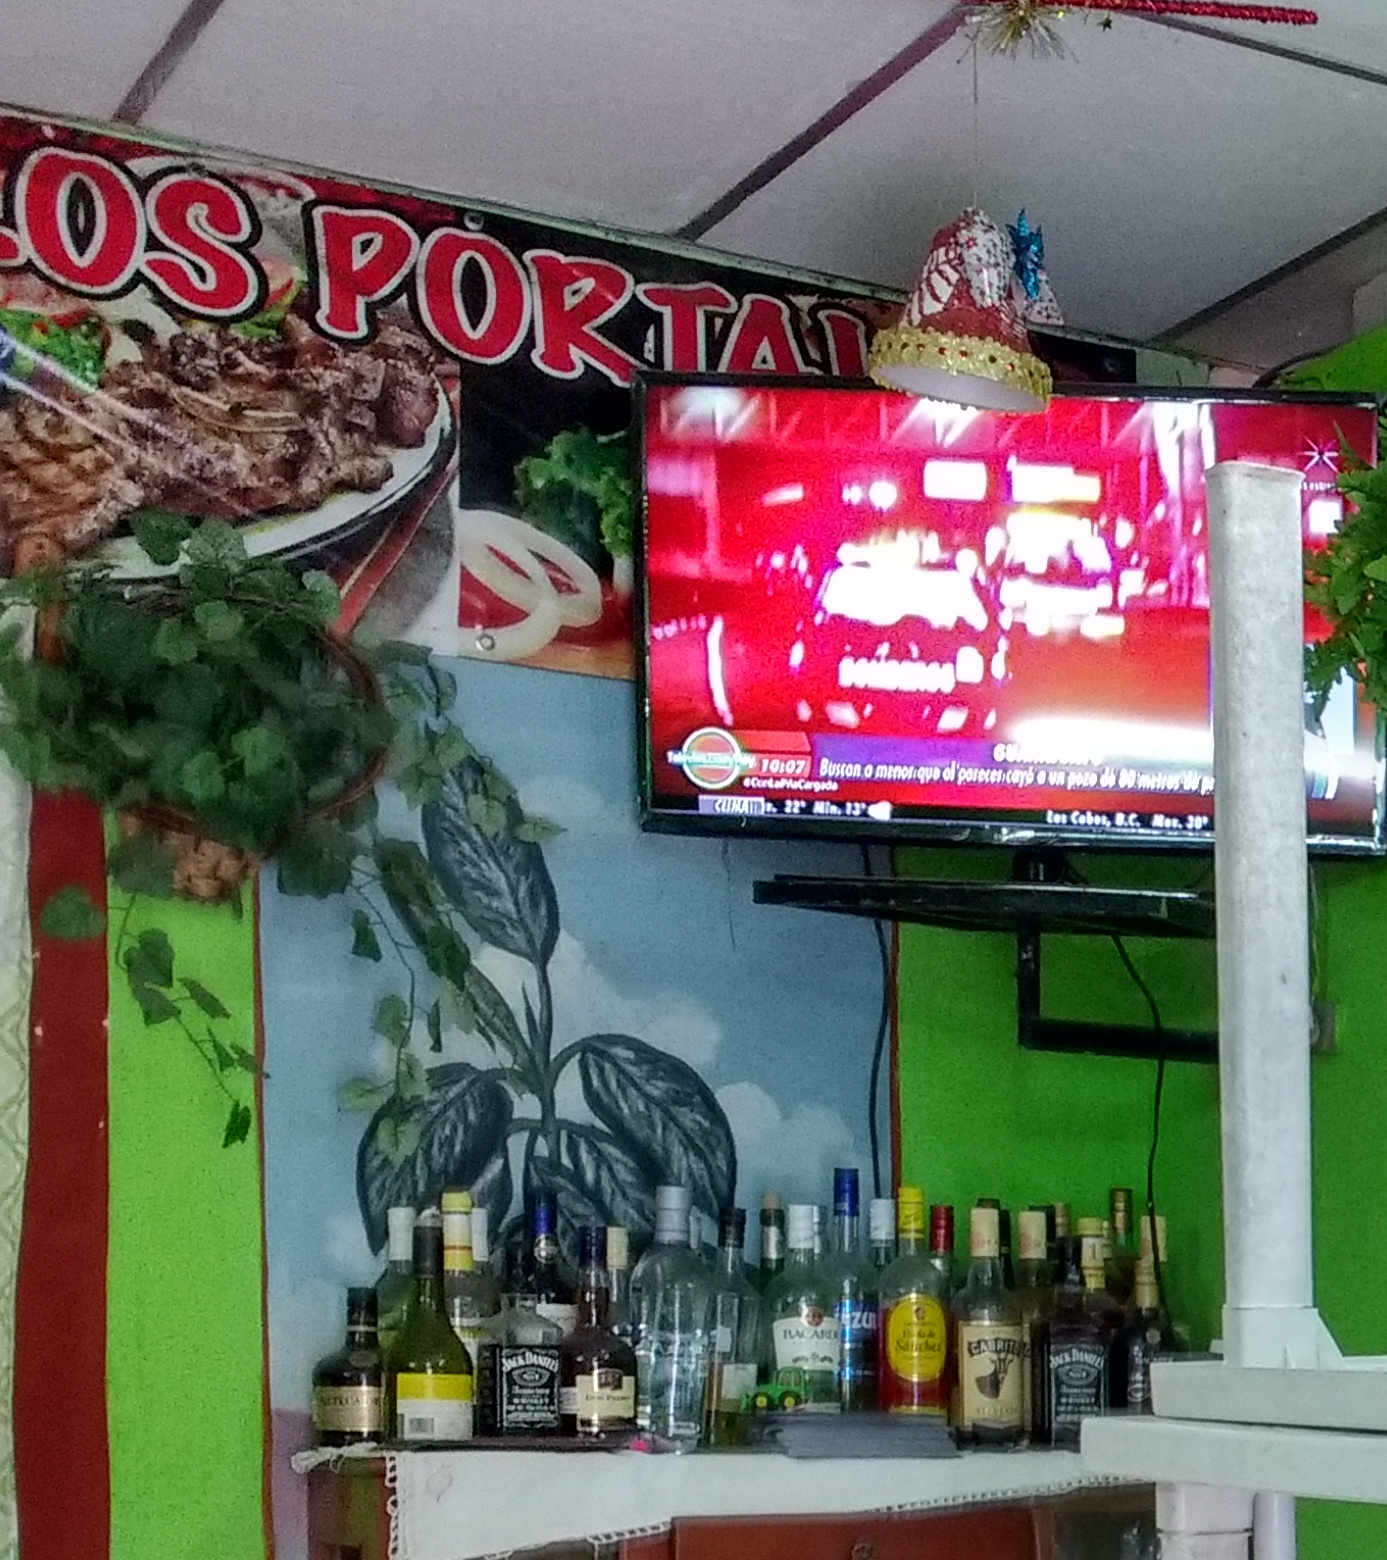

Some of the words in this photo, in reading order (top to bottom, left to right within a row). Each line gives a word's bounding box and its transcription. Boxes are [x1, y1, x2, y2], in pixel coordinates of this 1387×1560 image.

[0, 145, 260, 318] OS
[761, 759, 806, 775] 10:07
[820, 757, 861, 778] Buscan
[943, 761, 956, 781] al
[958, 765, 1000, 786] parecer
[1049, 773, 1065, 787] un
[1068, 771, 1098, 791] pozo
[1138, 772, 1180, 792] metros
[502, 1354, 525, 1373] JACK
